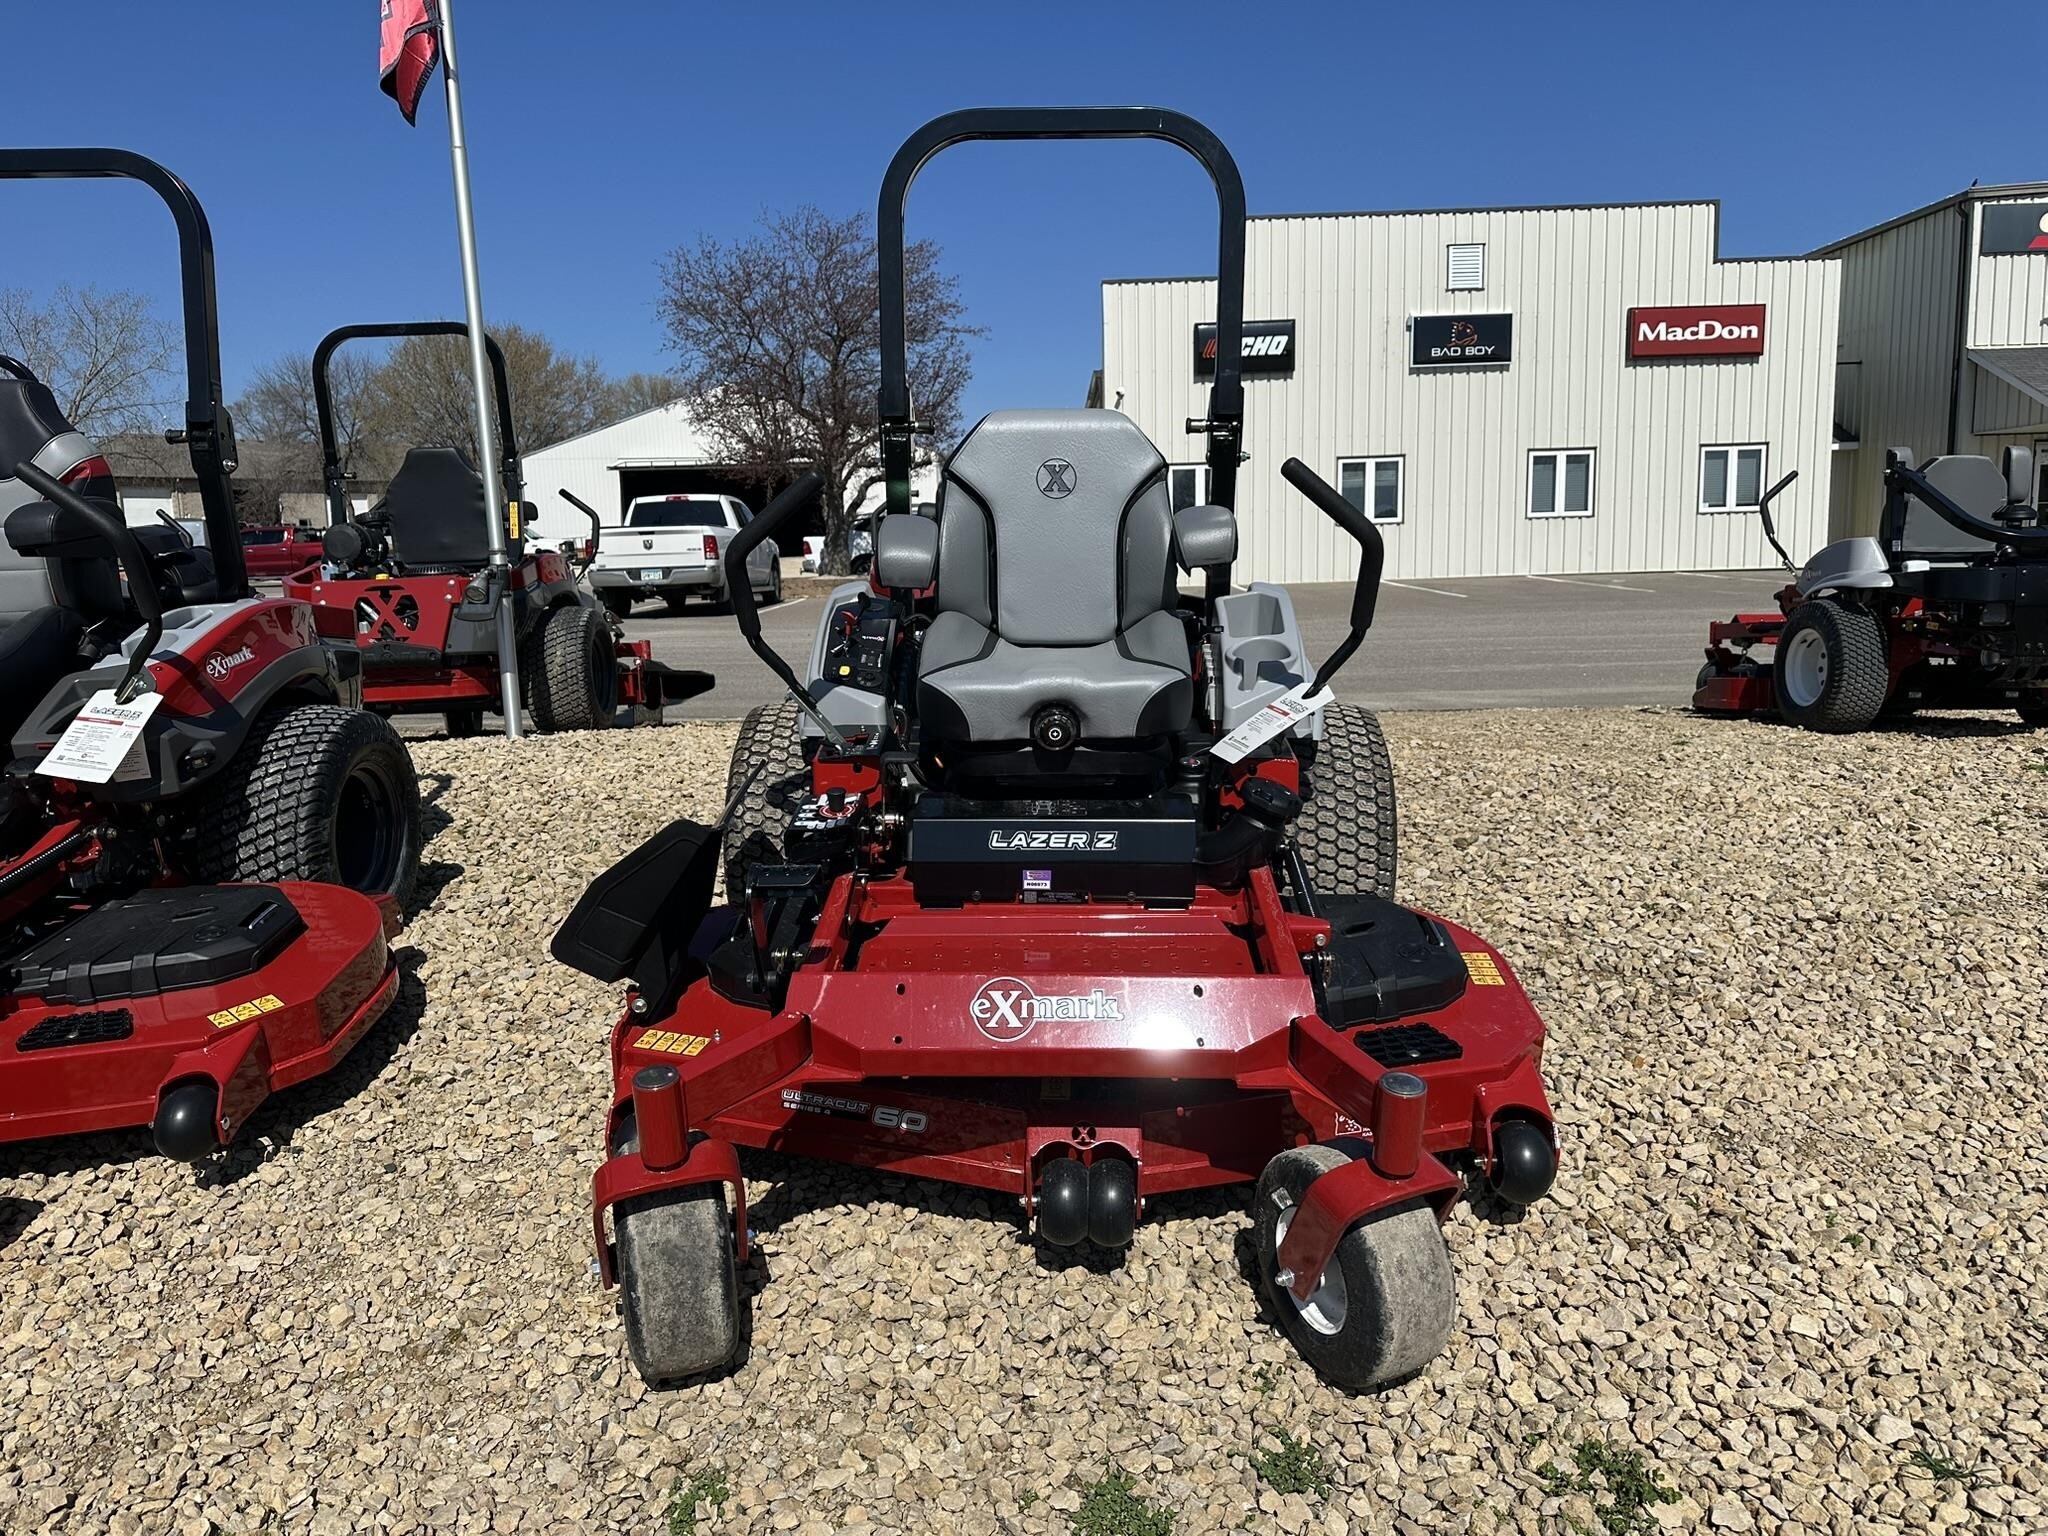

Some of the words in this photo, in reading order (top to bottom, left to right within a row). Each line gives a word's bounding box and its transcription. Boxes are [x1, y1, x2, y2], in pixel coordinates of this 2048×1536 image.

[1637, 320, 1759, 341] MacDon
[1240, 335, 1289, 357] CHO
[1431, 346, 1461, 357] BAD
[1465, 345, 1496, 356] BOY
[205, 645, 254, 678] eXmark
[989, 832, 1090, 850] LAZER
[1093, 832, 1117, 850] Z
[972, 988, 1120, 1030] eXmark
[782, 1089, 870, 1113] ULTRACUT
[873, 1105, 928, 1133] 60
[783, 1101, 821, 1113] SERIES
